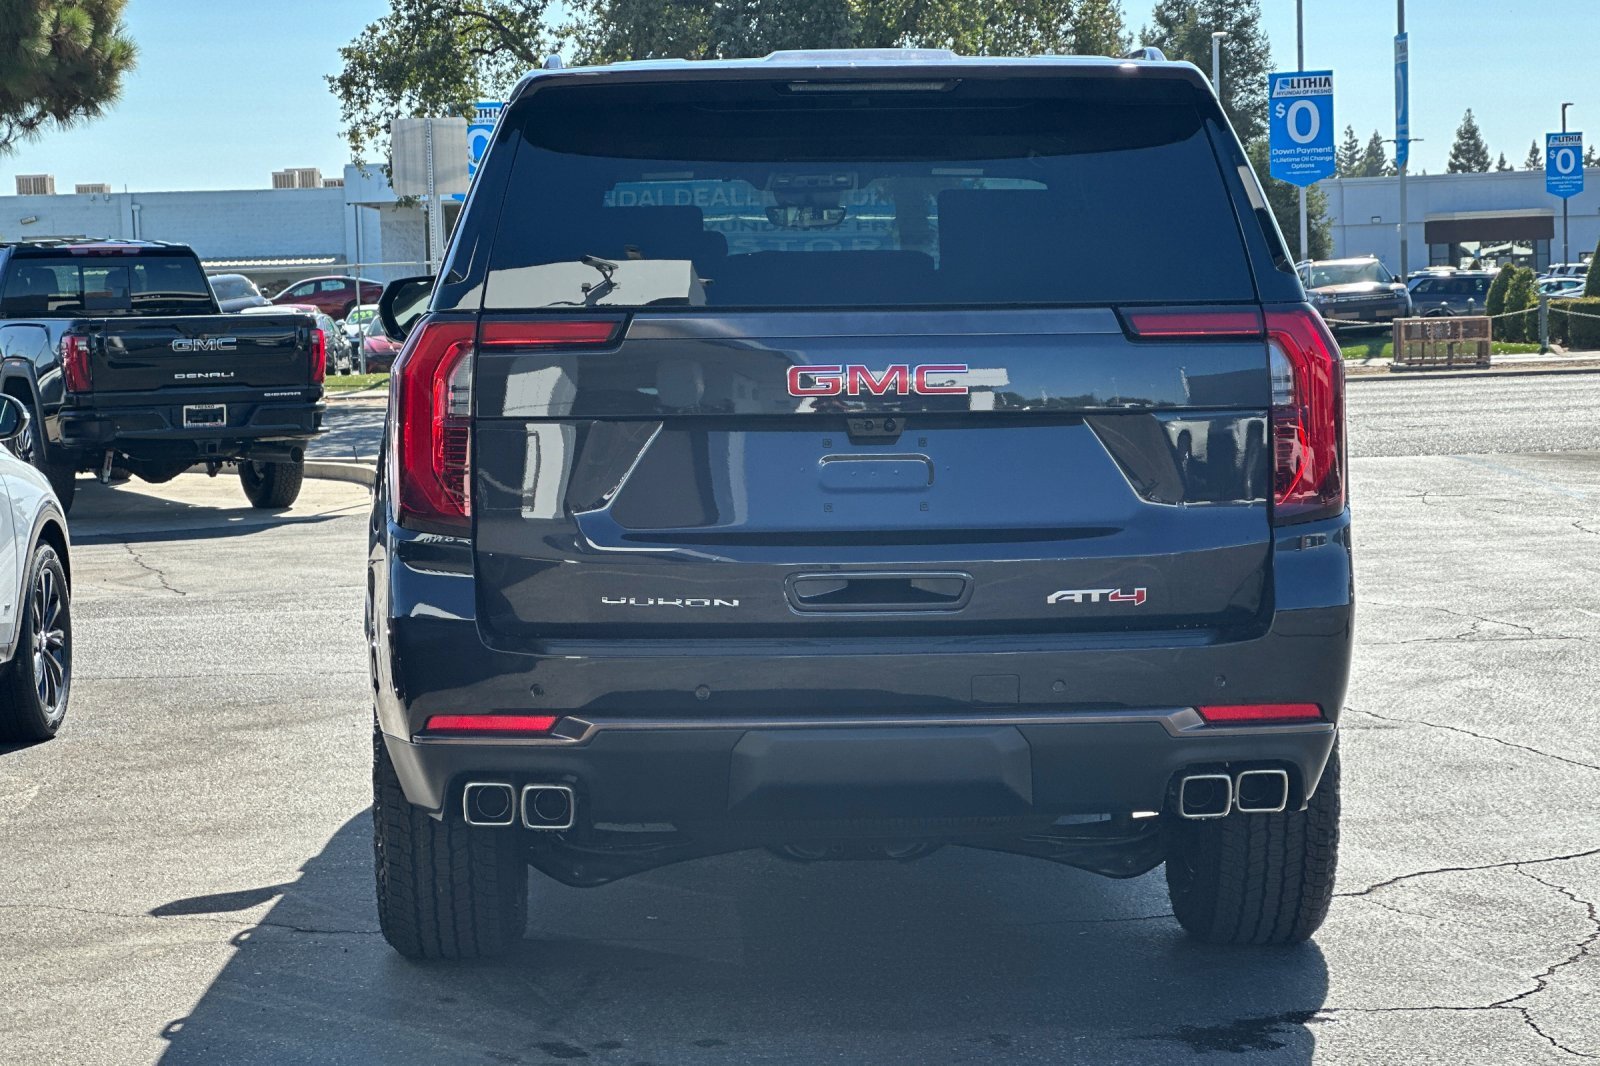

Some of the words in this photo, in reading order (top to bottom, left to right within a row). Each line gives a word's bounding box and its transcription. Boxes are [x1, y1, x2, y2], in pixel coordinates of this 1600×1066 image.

[1290, 76, 1332, 89] LITHIA
[1558, 135, 1582, 143] LITHIA
[1272, 148, 1296, 156] Down
[1296, 146, 1333, 155] Payment!
[172, 337, 237, 352] GMC
[174, 371, 235, 380] DENALI
[786, 363, 969, 397] GMC
[601, 596, 740, 608] YUKON
[1047, 587, 1147, 606] AT4
